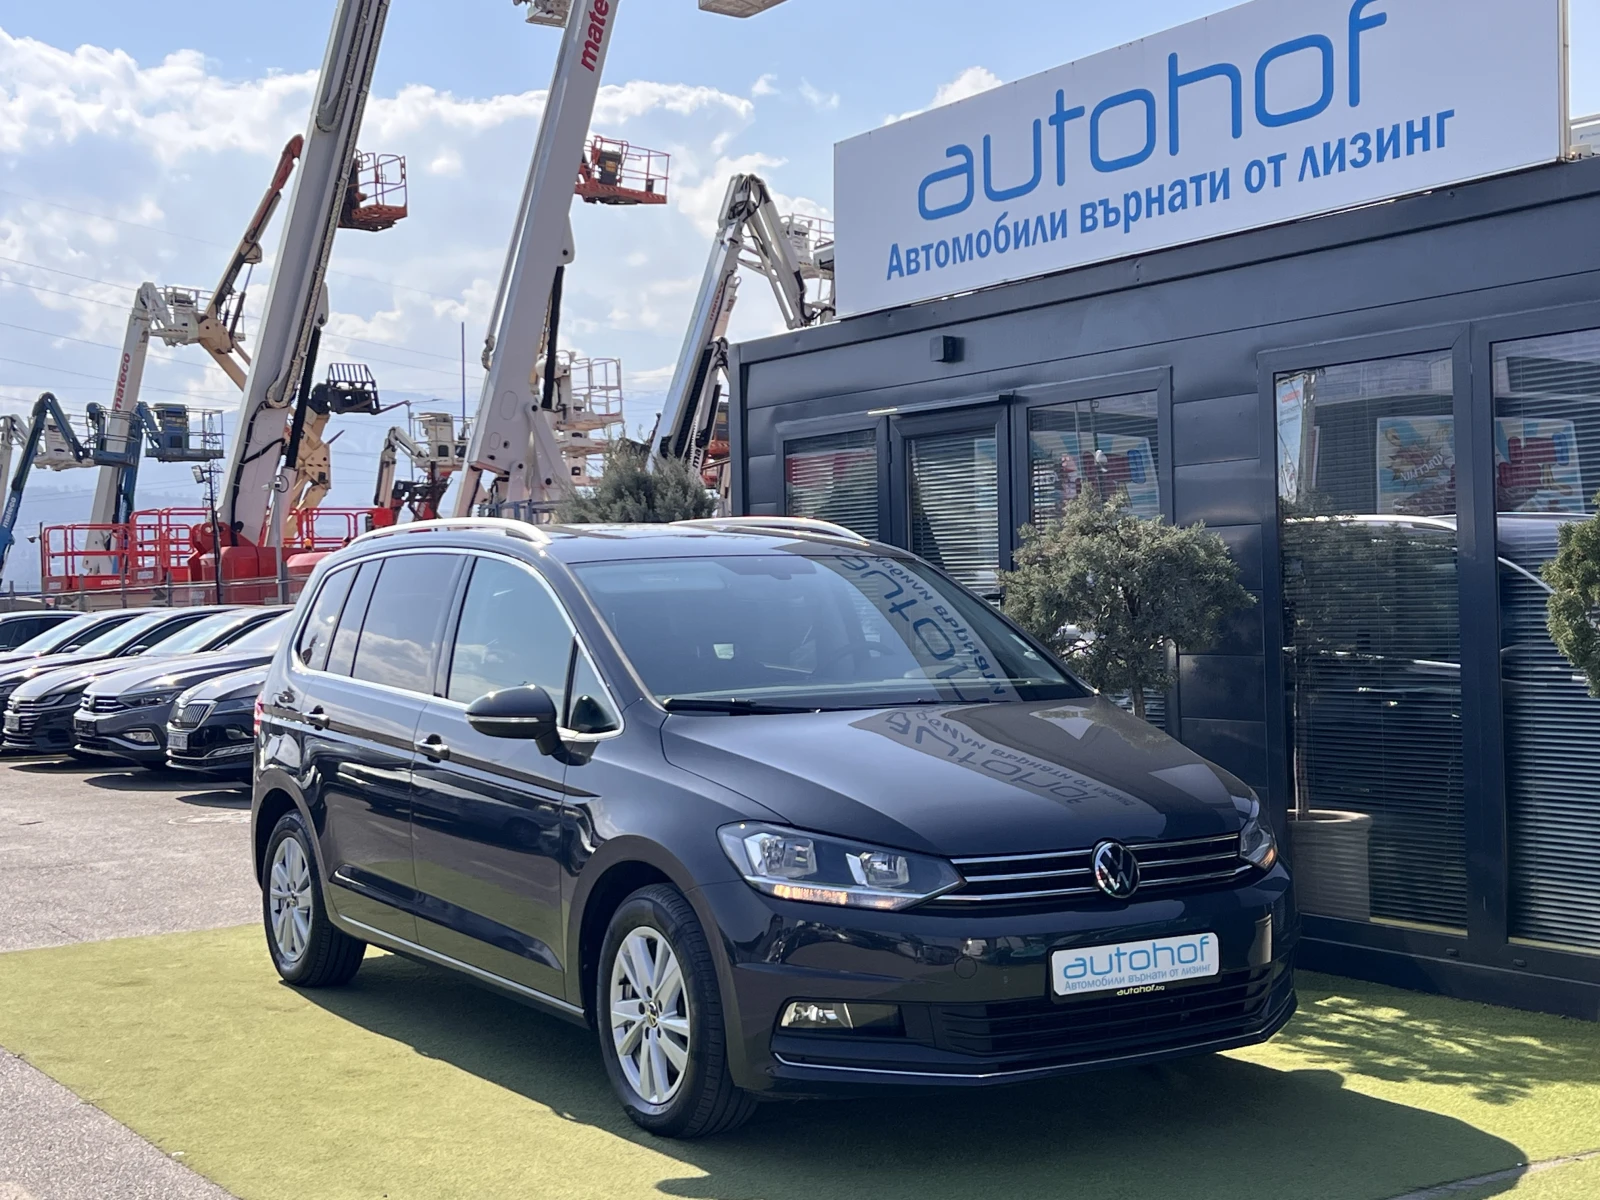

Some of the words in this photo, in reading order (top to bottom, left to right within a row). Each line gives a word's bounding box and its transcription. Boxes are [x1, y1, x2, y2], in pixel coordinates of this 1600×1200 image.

[917, 0, 1388, 221] autohof
[886, 208, 1068, 280] Автомобили
[1080, 167, 1231, 234] върнати
[1244, 152, 1288, 194] от
[1298, 108, 1456, 183] лизинг
[115, 352, 131, 412] mateco
[2, 496, 17, 529] mateco
[100, 578, 130, 586] mateo
[1063, 935, 1210, 979] autohof
[1064, 976, 1125, 992] Автомобили
[1128, 970, 1167, 985] върнати
[1169, 969, 1179, 978] от
[1181, 963, 1212, 976] лизинг
[1117, 983, 1165, 996] autohof.bg
